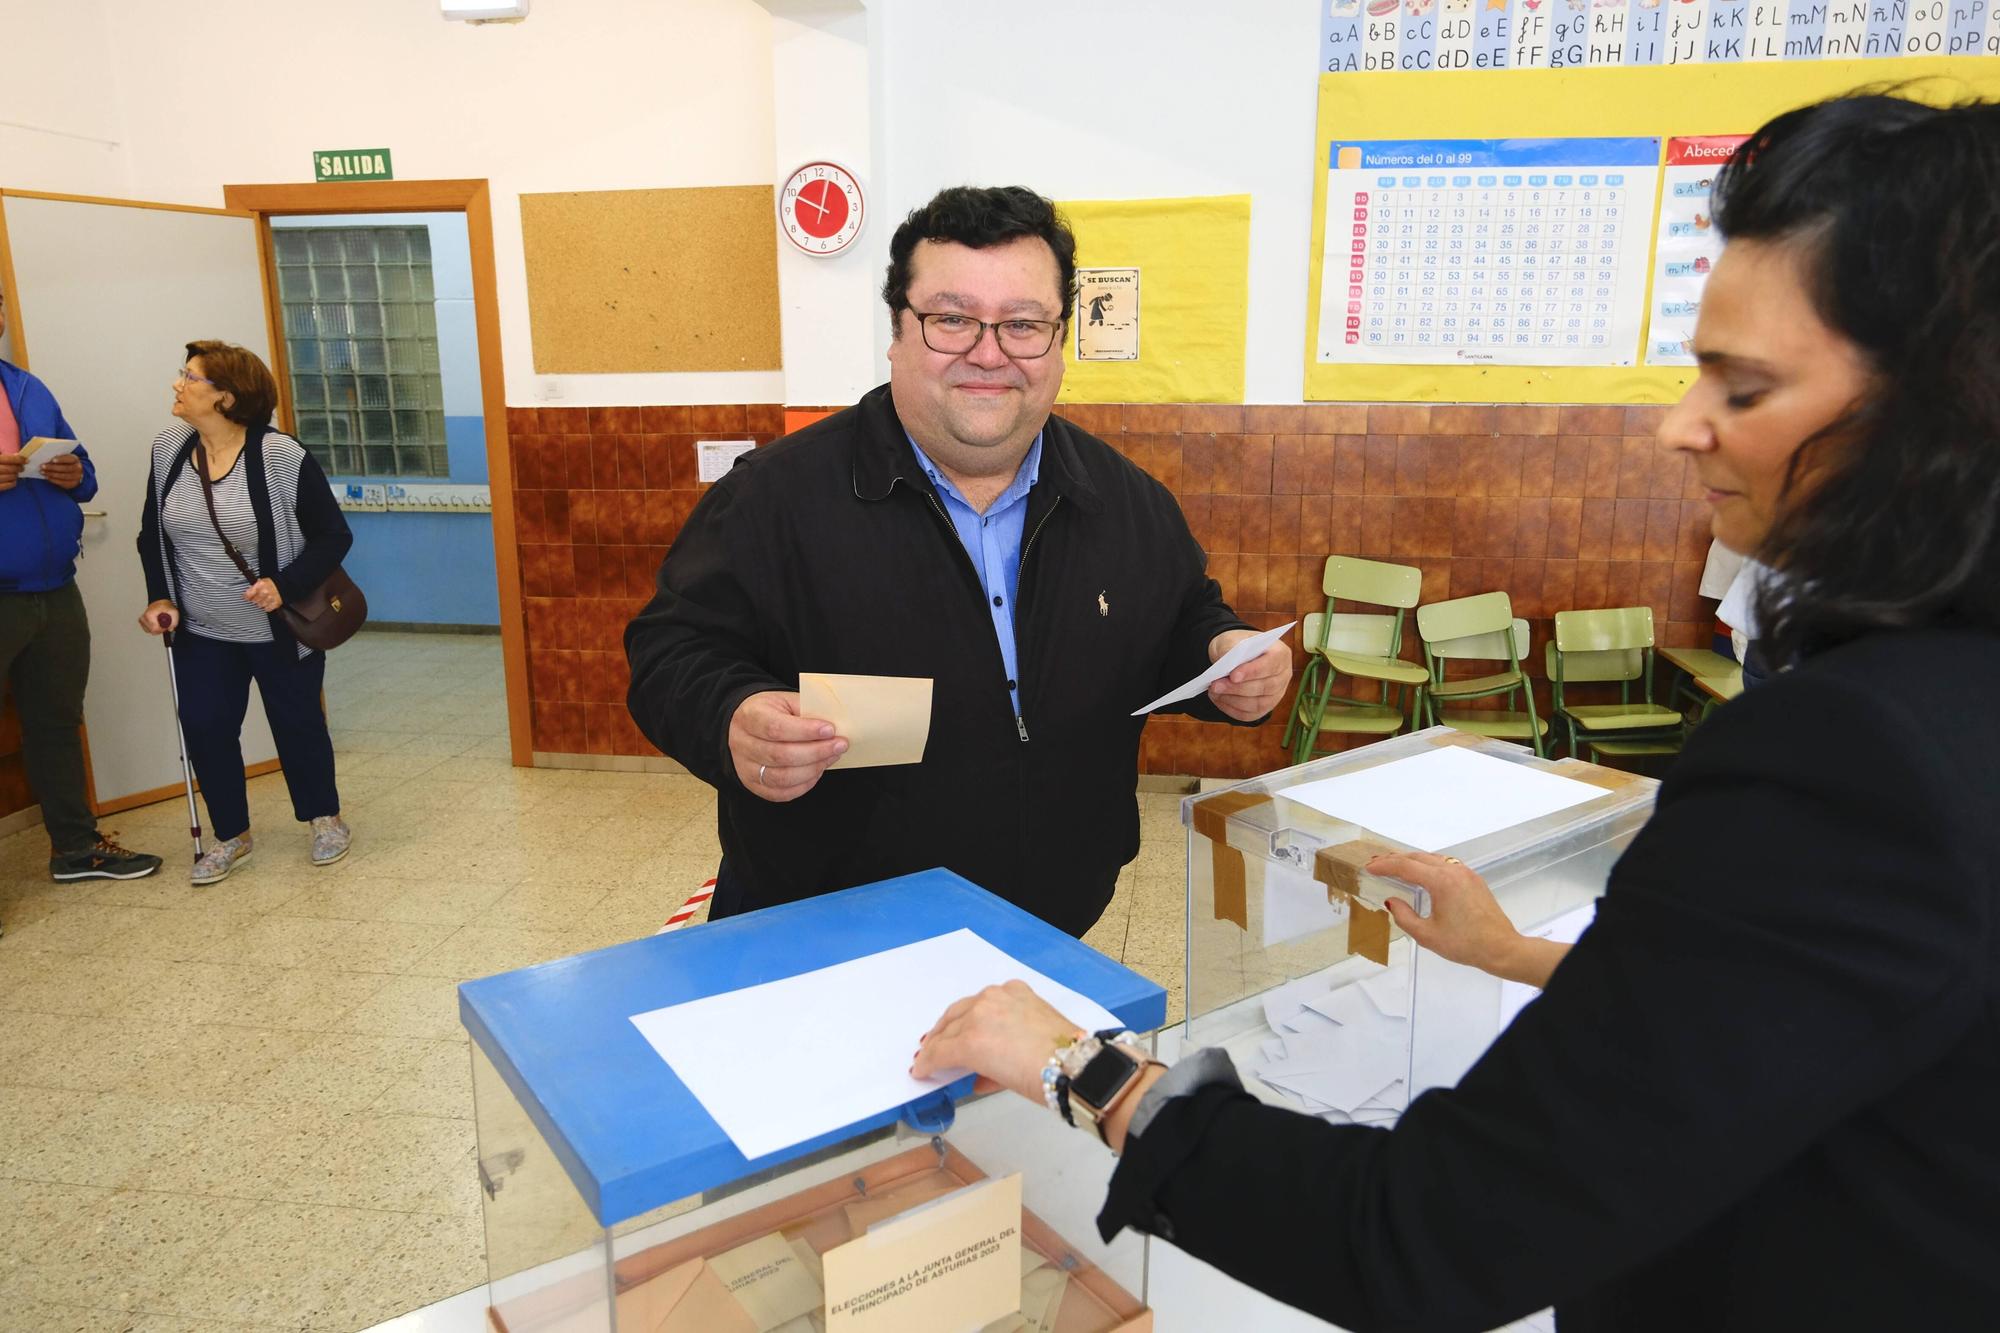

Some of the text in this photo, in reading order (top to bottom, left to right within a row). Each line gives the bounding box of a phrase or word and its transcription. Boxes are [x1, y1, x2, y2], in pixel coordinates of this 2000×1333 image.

[1684, 144, 1737, 158] Abeced
[1366, 153, 1472, 165] Números del 0 al 99
[320, 154, 386, 176] SALIDA
[814, 168, 824, 177] 12
[835, 172, 839, 180] 1
[799, 174, 807, 183] 11
[787, 188, 796, 197] 10
[847, 185, 853, 194] 2
[785, 207, 790, 215] 9
[853, 203, 858, 212] 3
[791, 225, 796, 233] 8
[849, 221, 854, 230] 4
[804, 237, 809, 246] 7
[838, 235, 843, 244] 5
[821, 241, 826, 249] 6
[832, 1227, 1016, 1314] ELECCIONES A LA JUNTA GENERAL DEL
[852, 1244, 1001, 1316] PRINCIPADO DE ASTURIAS 2023
